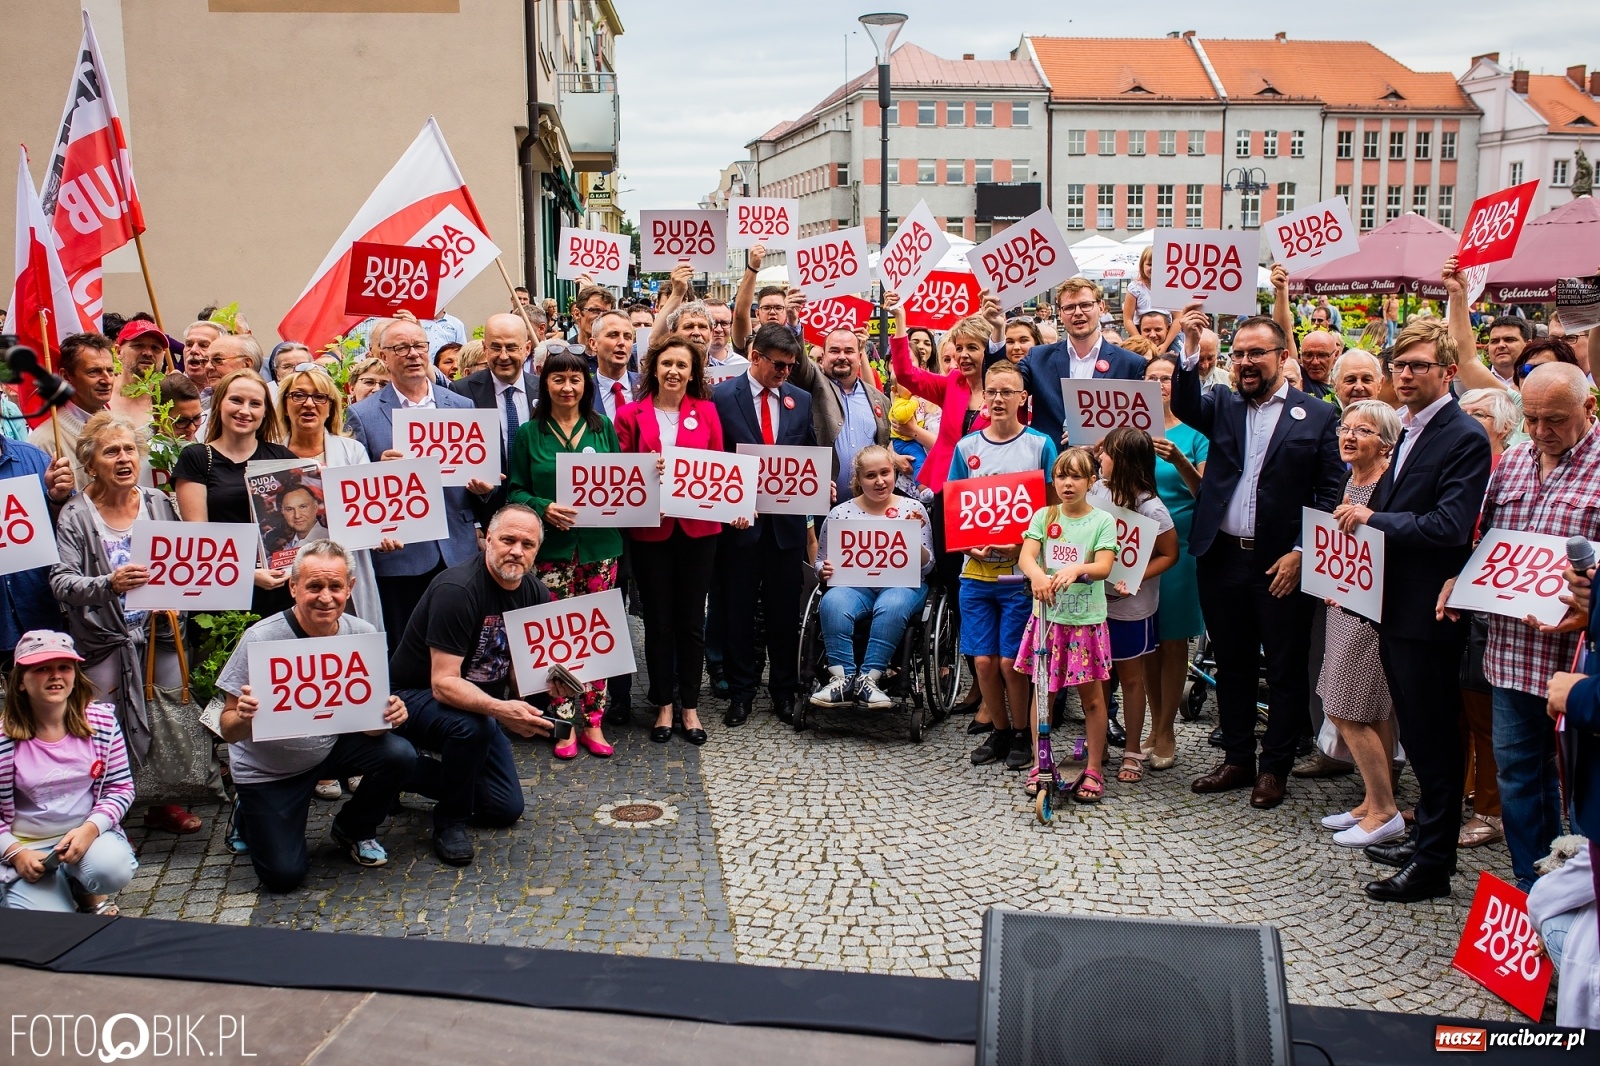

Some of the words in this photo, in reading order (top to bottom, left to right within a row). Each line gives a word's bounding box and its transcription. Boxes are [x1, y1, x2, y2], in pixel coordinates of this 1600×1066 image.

[738, 205, 789, 221] DUDA
[1471, 197, 1520, 231] DUDA
[421, 224, 464, 250] DA
[653, 220, 714, 239] DUDA
[738, 220, 790, 235] 2020
[1278, 210, 1339, 244] DUDA
[1463, 218, 1515, 250] 2020
[569, 236, 620, 257] DUDA
[653, 237, 716, 255] 2020
[796, 240, 856, 269] DUDA
[883, 221, 926, 277] DUDA
[981, 227, 1049, 276] DUDA
[1166, 242, 1242, 268] DUDA
[1283, 225, 1343, 259] 2020
[366, 256, 429, 280] DUDA
[569, 252, 620, 271] 2020
[800, 257, 858, 286] 2020
[889, 232, 933, 290] 2020
[991, 245, 1056, 293] 2020
[362, 276, 428, 300] 2020
[914, 280, 970, 300] DUDA
[1165, 266, 1242, 292] 2020
[1314, 282, 1349, 293] Gelateria
[1351, 280, 1369, 290] Ciao
[1370, 279, 1395, 289] Italia
[910, 295, 969, 316] 2020
[1499, 287, 1550, 301] Gelateria
[1077, 390, 1149, 412] DUDA
[409, 421, 485, 444] DUDA
[1081, 410, 1151, 430] 2020
[410, 443, 487, 465] 2020
[251, 475, 277, 487] DUDA
[572, 465, 646, 487] DUDA
[674, 458, 743, 485] DUDA
[253, 484, 278, 494] 2020
[341, 472, 426, 504] DUDA
[572, 486, 647, 507] 2020
[671, 478, 744, 504] 2020
[959, 484, 1032, 511] DUDA
[345, 495, 430, 528] 2020
[959, 503, 1033, 530] 2020
[841, 530, 907, 550] DUDA
[1116, 518, 1140, 550] DA
[1315, 525, 1373, 568] DUDA
[150, 536, 239, 562] DUDA
[841, 549, 908, 569] 2020
[1053, 545, 1078, 555] DUDA
[1053, 553, 1078, 562] 2020
[147, 561, 239, 587] 2020
[1314, 550, 1373, 591] 2020
[1472, 563, 1564, 597] 2020
[524, 608, 610, 646] DUDA
[530, 631, 615, 669] 2020
[269, 651, 369, 685] DUDA
[273, 677, 372, 712] 2020
[1473, 923, 1540, 981] 2020
